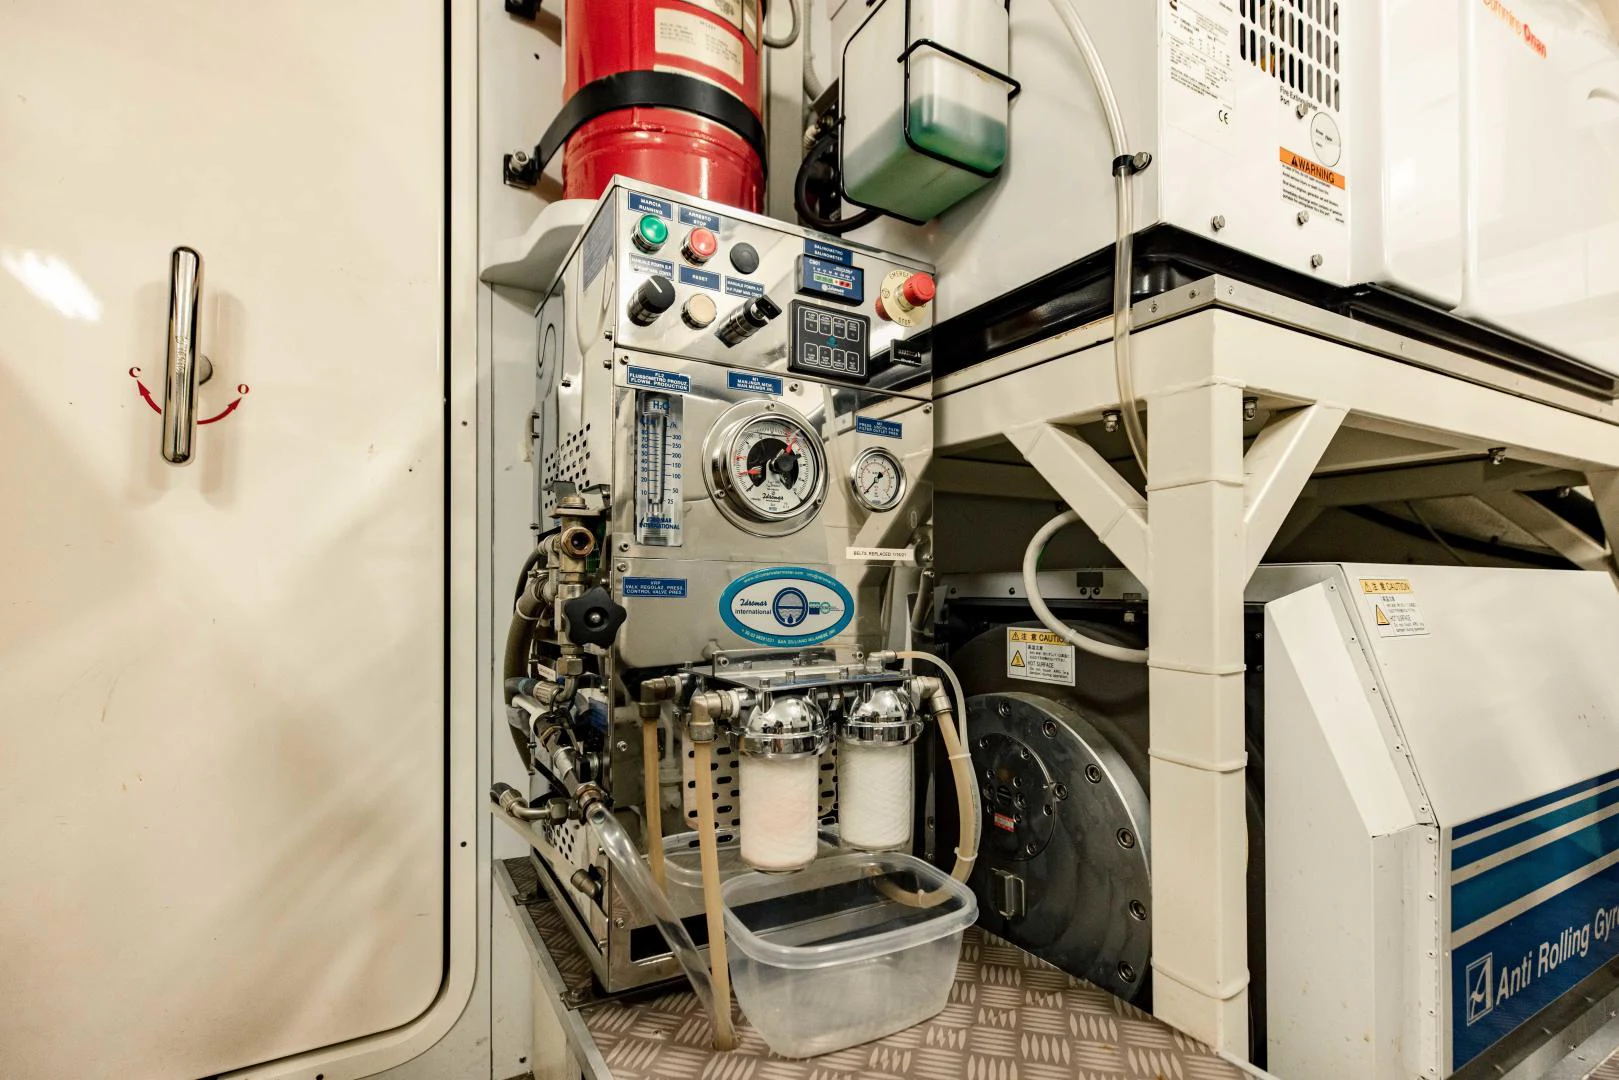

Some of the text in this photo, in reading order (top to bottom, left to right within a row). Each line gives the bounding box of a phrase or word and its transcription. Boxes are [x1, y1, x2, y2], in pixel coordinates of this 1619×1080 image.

[1299, 158, 1334, 184] WARNING
[640, 198, 662, 208] MARCIA
[639, 205, 663, 215] RUNNING
[688, 212, 712, 222] ARRESTO
[129, 366, 141, 378] C
[237, 384, 250, 394] O
[654, 381, 688, 390] PRODUCTION
[1039, 634, 1065, 643] CAUTIO
[1496, 950, 1532, 1006] Anti
[1537, 923, 1590, 978] Rolling
